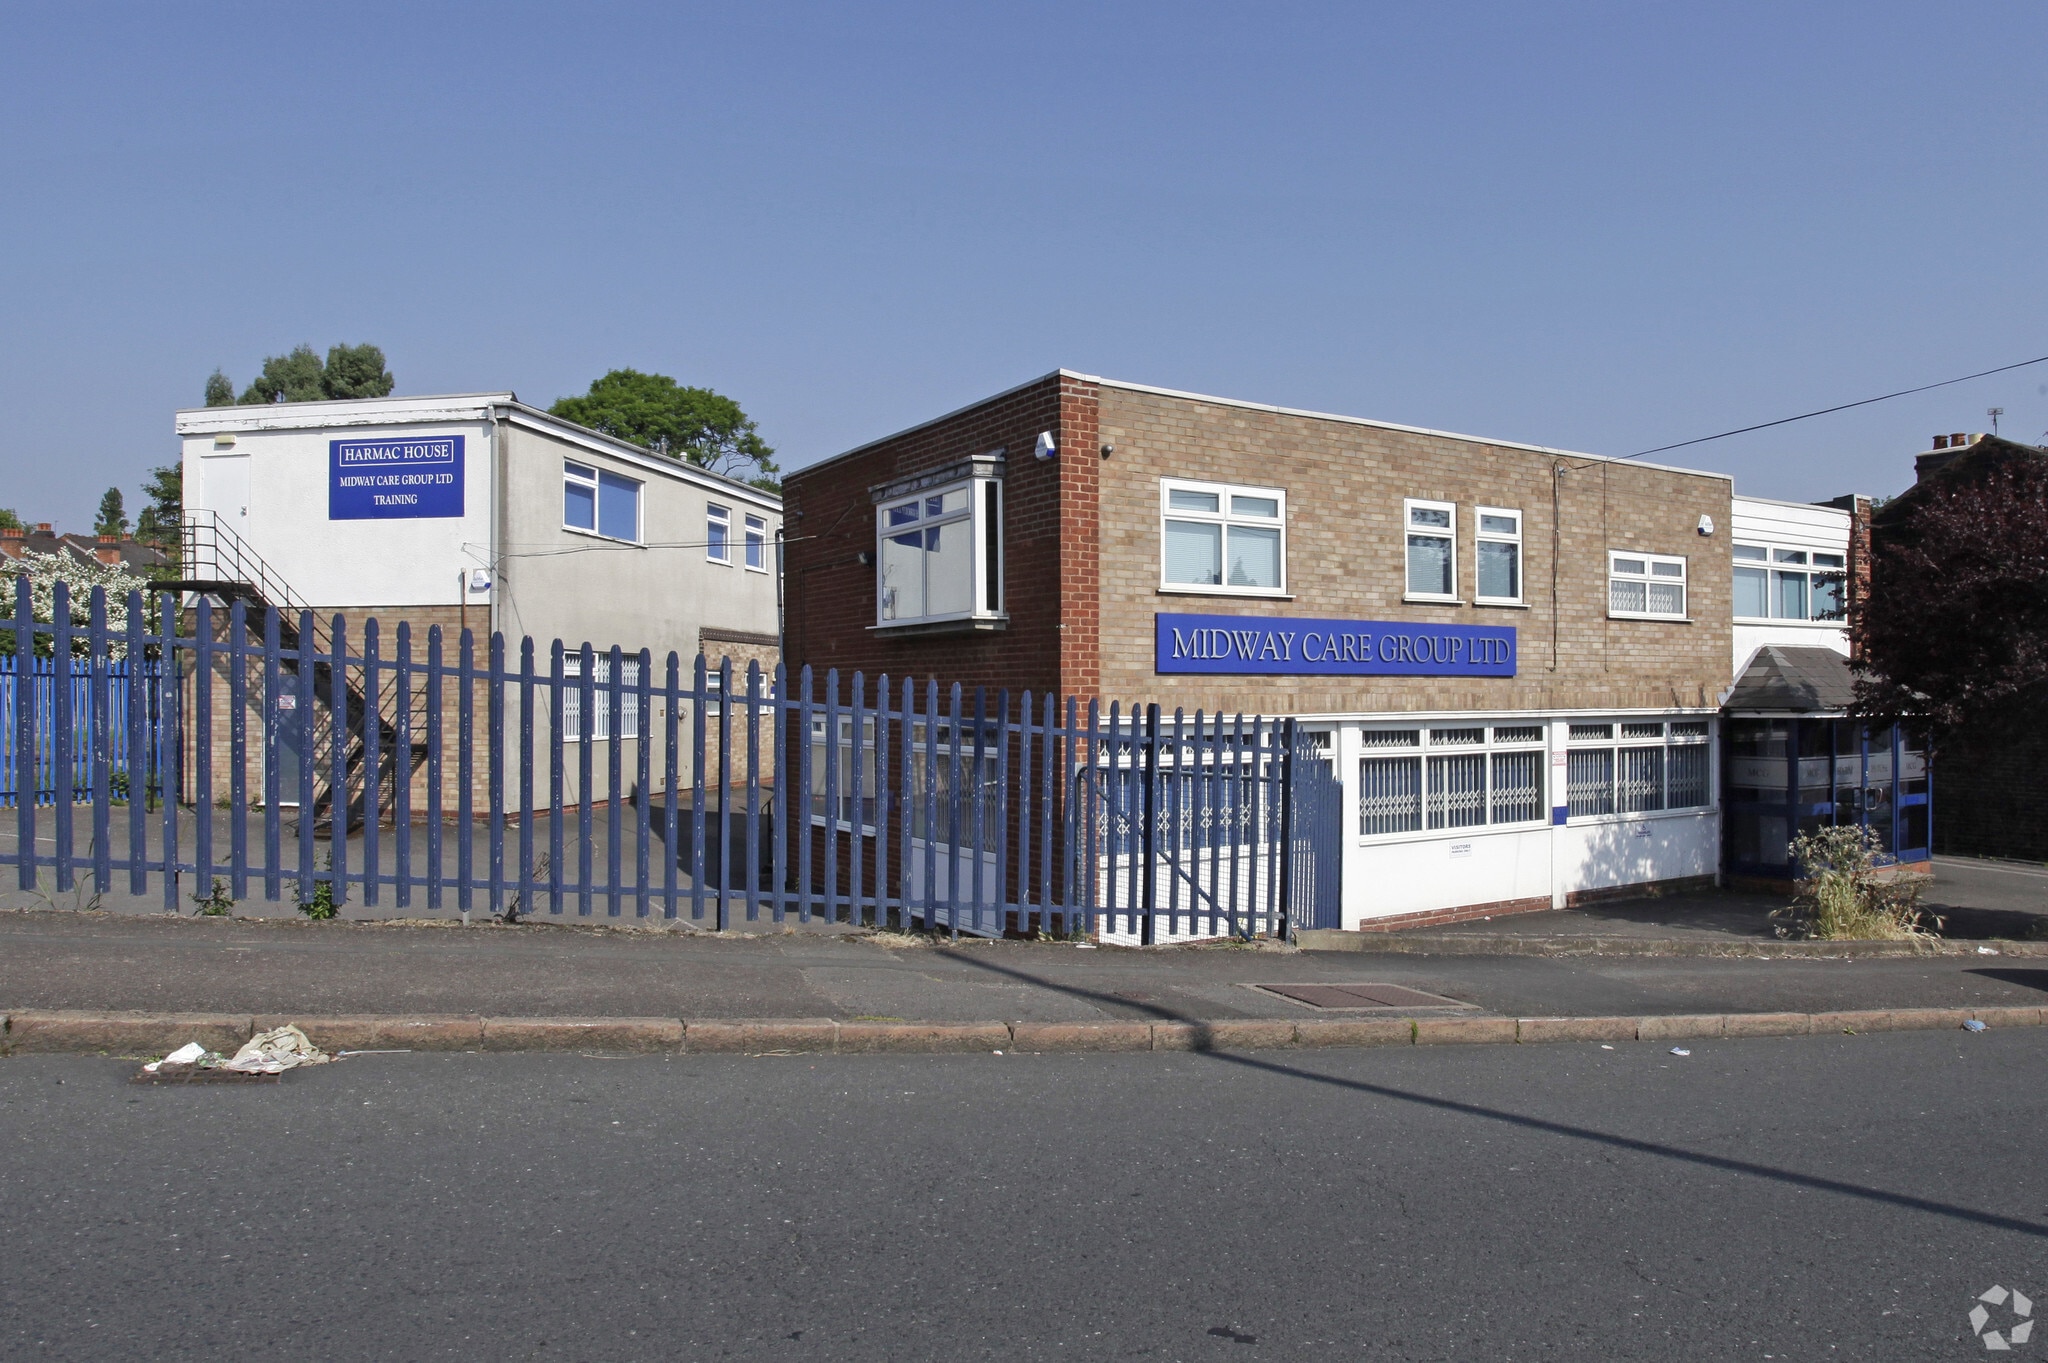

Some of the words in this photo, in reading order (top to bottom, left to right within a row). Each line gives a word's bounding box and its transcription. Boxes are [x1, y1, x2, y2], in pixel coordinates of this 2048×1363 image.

[345, 446, 401, 461] HARMAC
[404, 444, 449, 459] HOUSE
[340, 475, 376, 487] MIDWAY
[376, 474, 400, 486] CARE
[402, 473, 434, 485] GROUP
[435, 473, 453, 484] LTD
[374, 494, 418, 505] TRAINING
[1172, 628, 1296, 661] MIDWAY
[1302, 632, 1374, 663] CARE
[1379, 635, 1463, 663] GROUP
[1468, 637, 1511, 664] LTD
